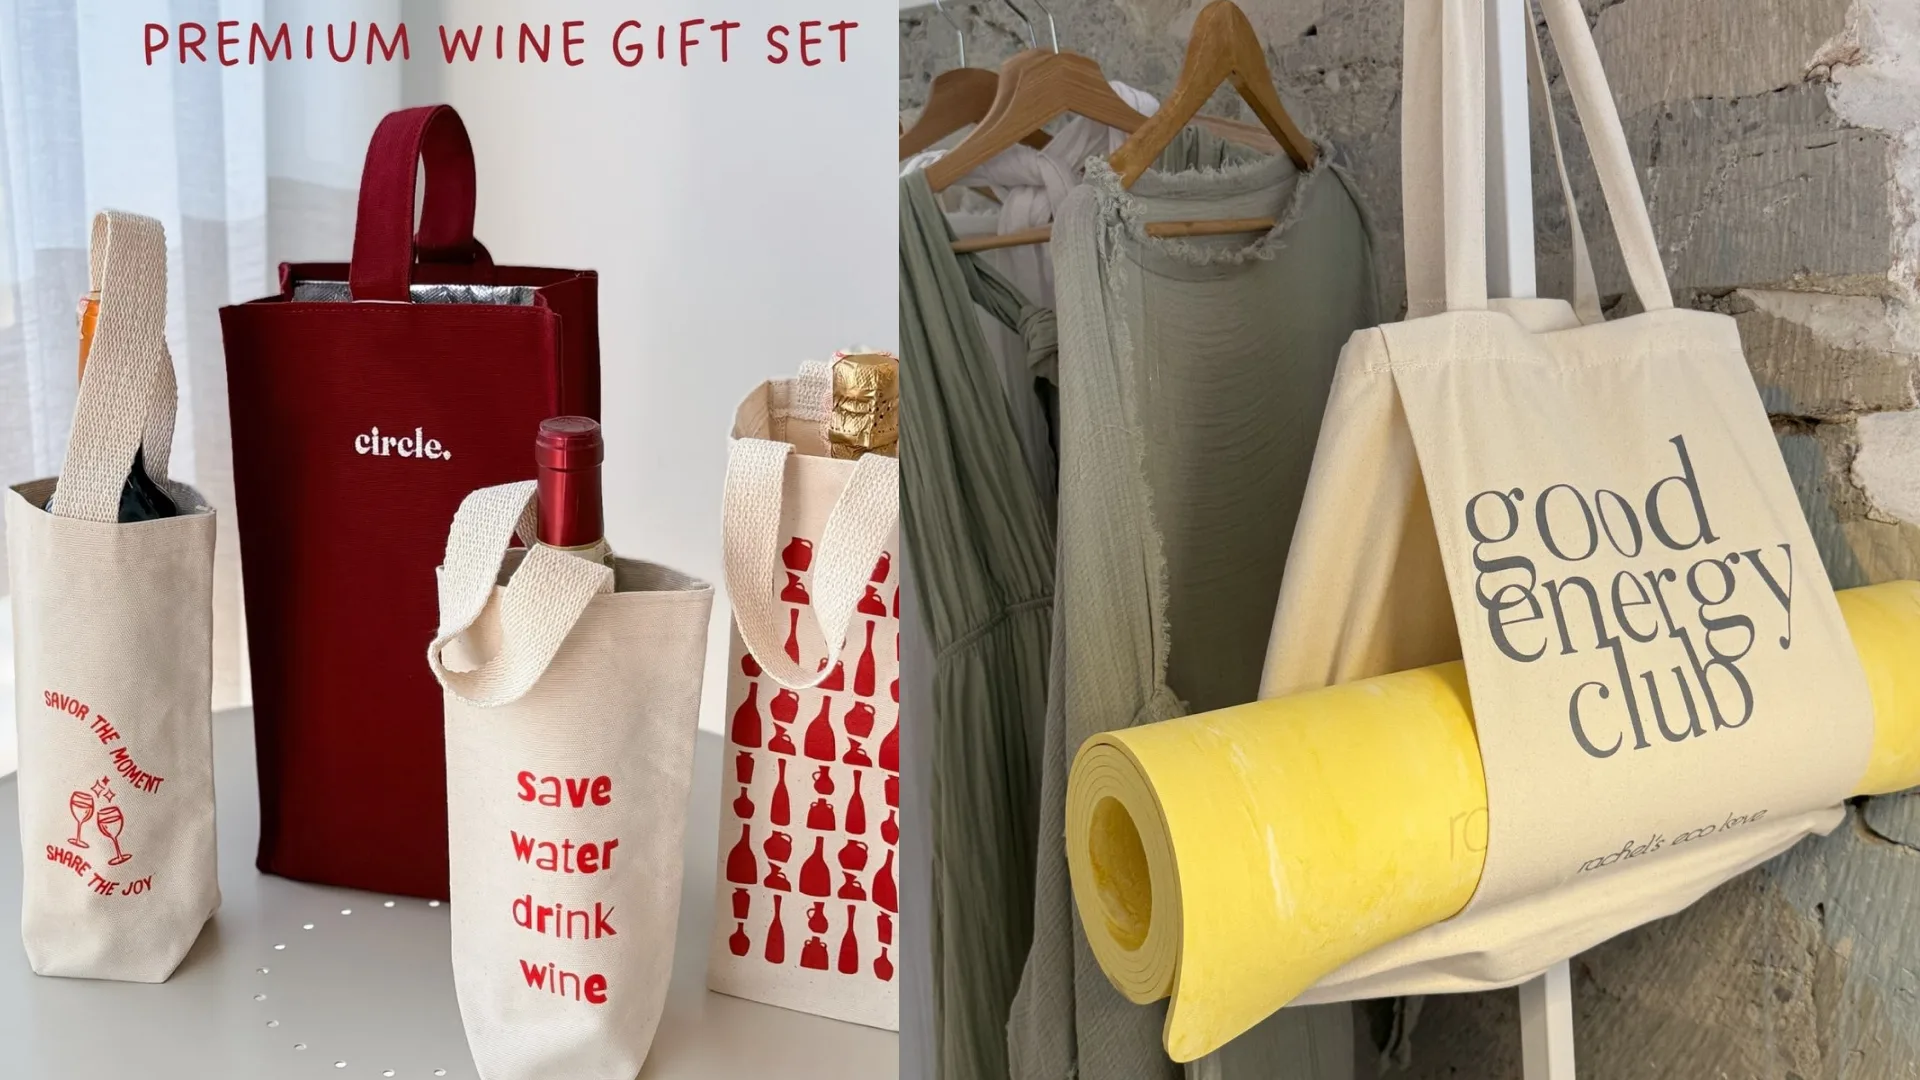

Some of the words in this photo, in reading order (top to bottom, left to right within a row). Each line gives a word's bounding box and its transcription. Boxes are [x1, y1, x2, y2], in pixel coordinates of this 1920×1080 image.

[354, 426, 452, 461] circle.
[1465, 434, 1720, 611] good
[1487, 543, 1792, 663] energy
[1568, 626, 1754, 759] club
[44, 690, 91, 721] SAVOR
[90, 714, 121, 745] THE
[109, 746, 164, 794] MOMENT
[516, 770, 612, 808] save
[510, 830, 619, 874] water
[1670, 824, 1717, 846] eco
[46, 845, 92, 877] SHARE
[87, 872, 120, 896] THE
[122, 875, 153, 896] JOY
[512, 894, 618, 940] drink
[519, 959, 608, 1004] wine
